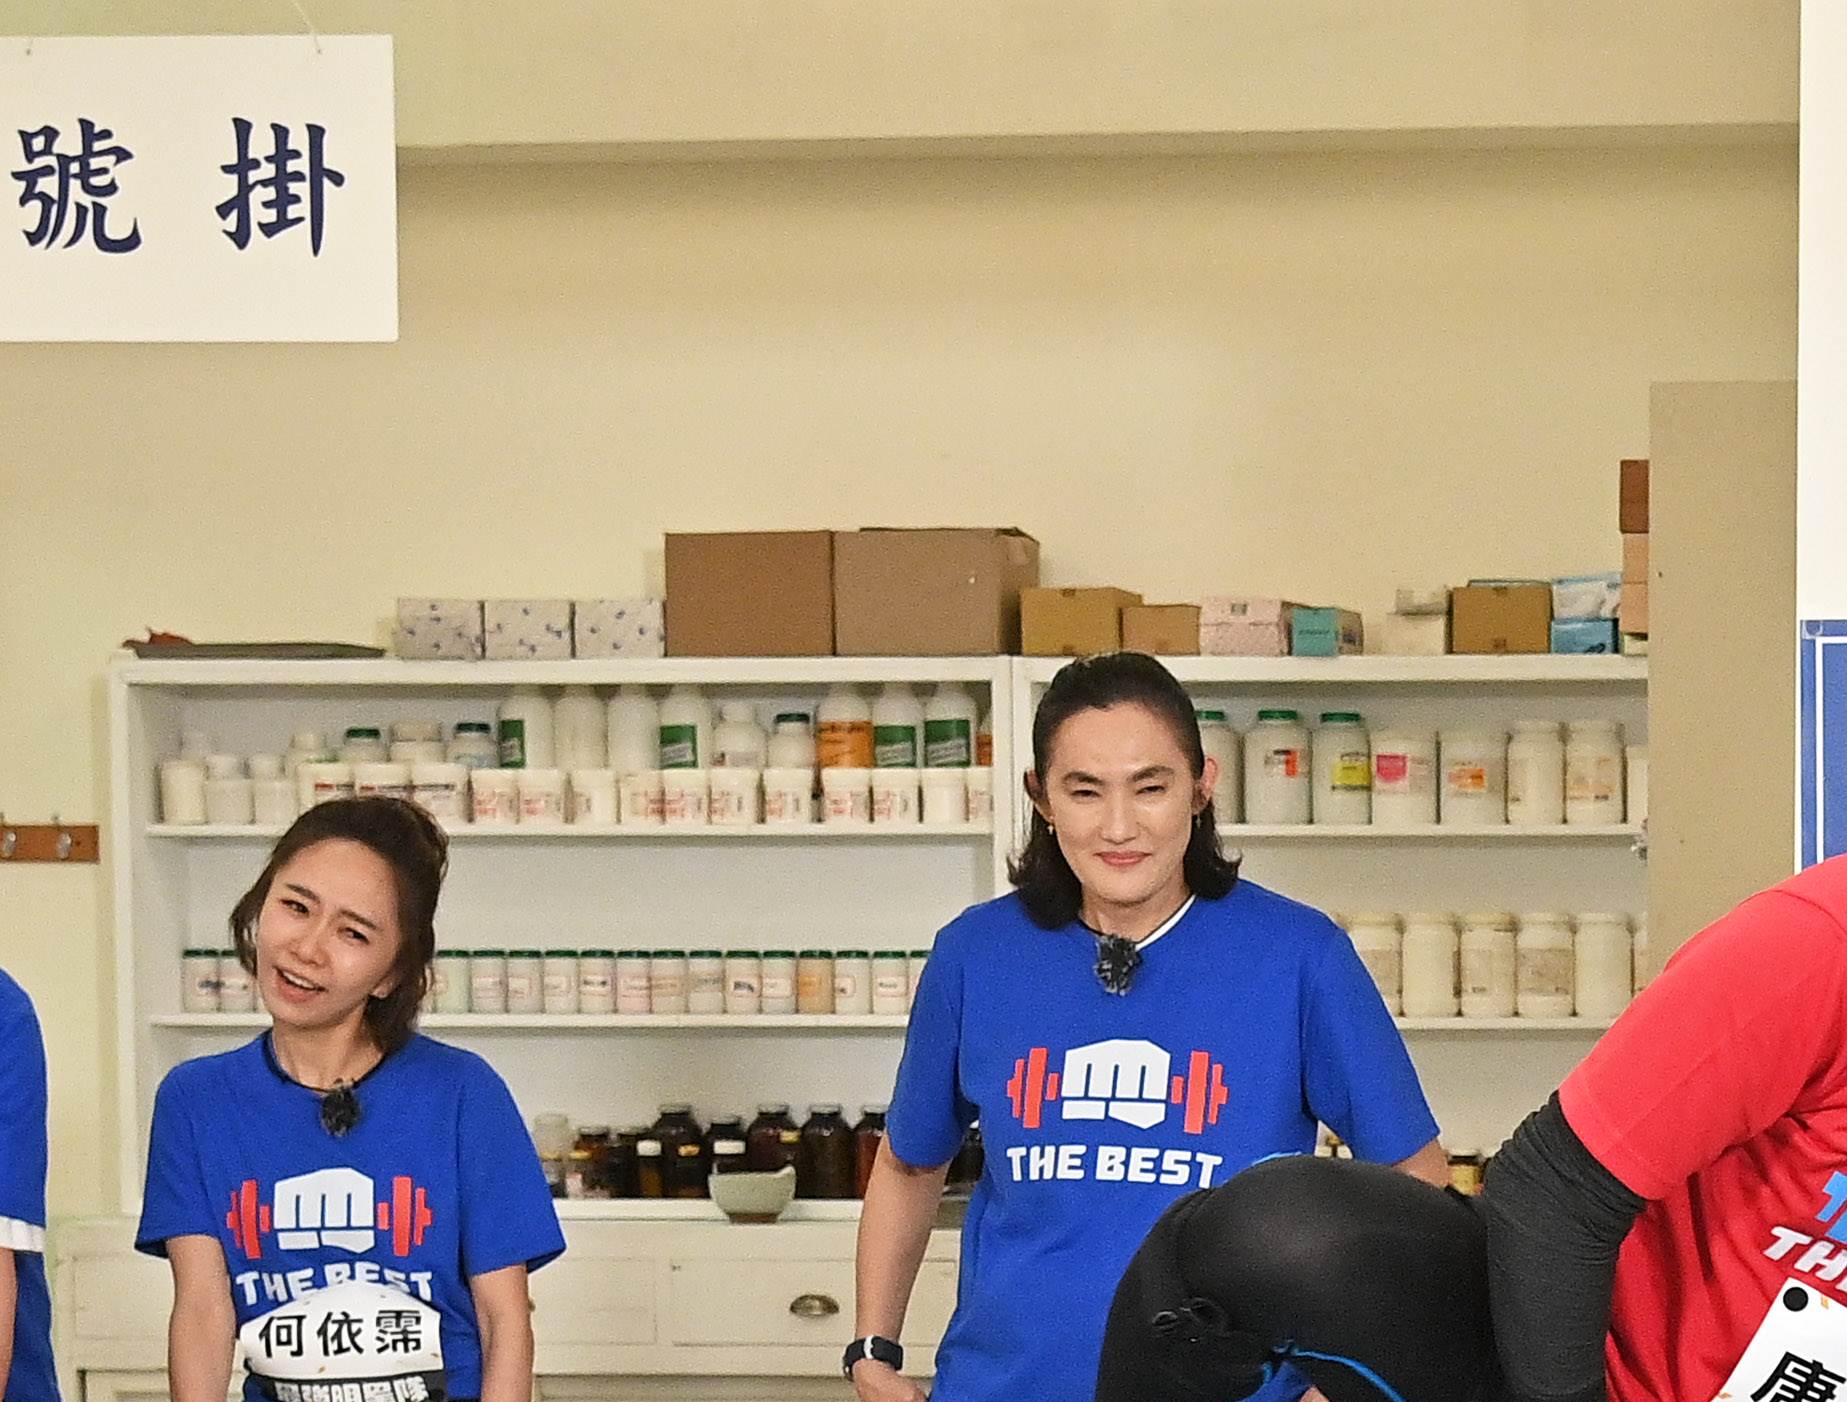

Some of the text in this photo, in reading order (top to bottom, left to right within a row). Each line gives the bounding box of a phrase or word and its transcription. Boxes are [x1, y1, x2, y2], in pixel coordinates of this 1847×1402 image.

[1006, 1145, 1224, 1190] THE BEST
[236, 1267, 319, 1306] THE
[258, 1309, 422, 1359] 何依霈
